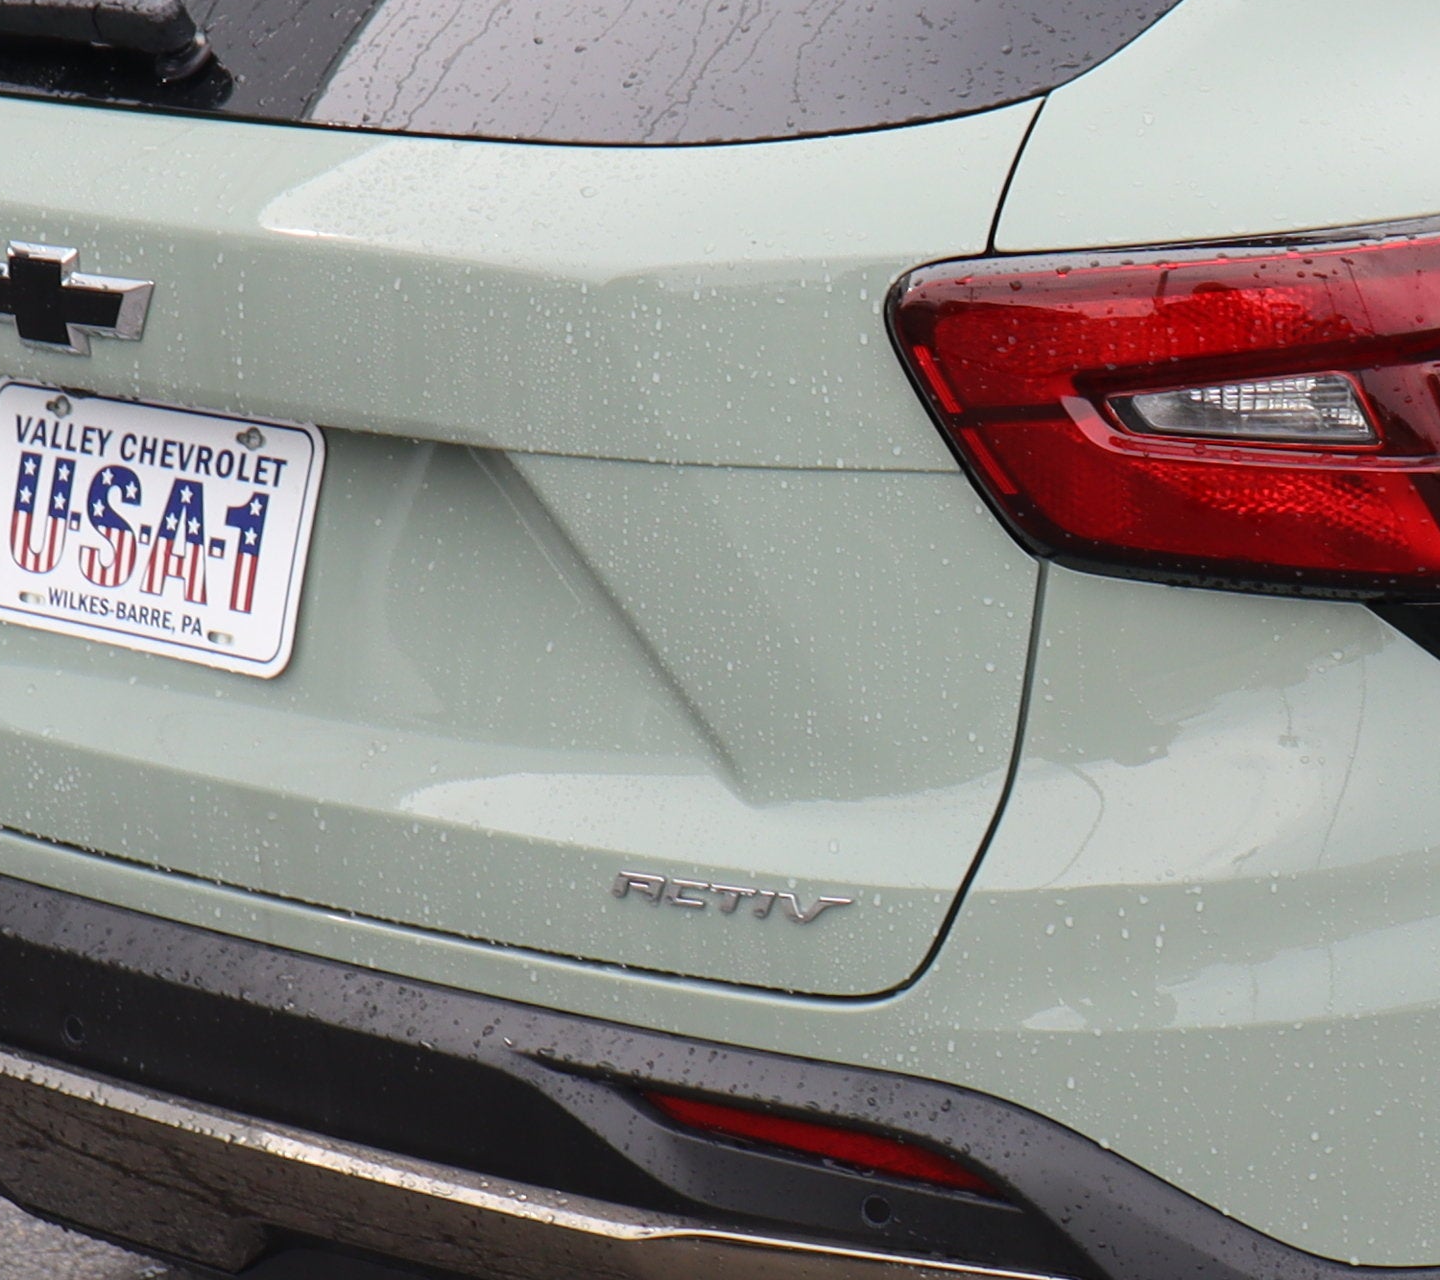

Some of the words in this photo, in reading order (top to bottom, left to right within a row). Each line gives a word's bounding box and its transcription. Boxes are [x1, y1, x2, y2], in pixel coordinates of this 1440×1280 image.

[15, 414, 112, 458] VALLEY
[119, 432, 288, 488] CHEVROLET
[48, 586, 176, 634] WILKES-BARRE,
[181, 616, 204, 638] PA
[612, 871, 854, 924] ACTIV
